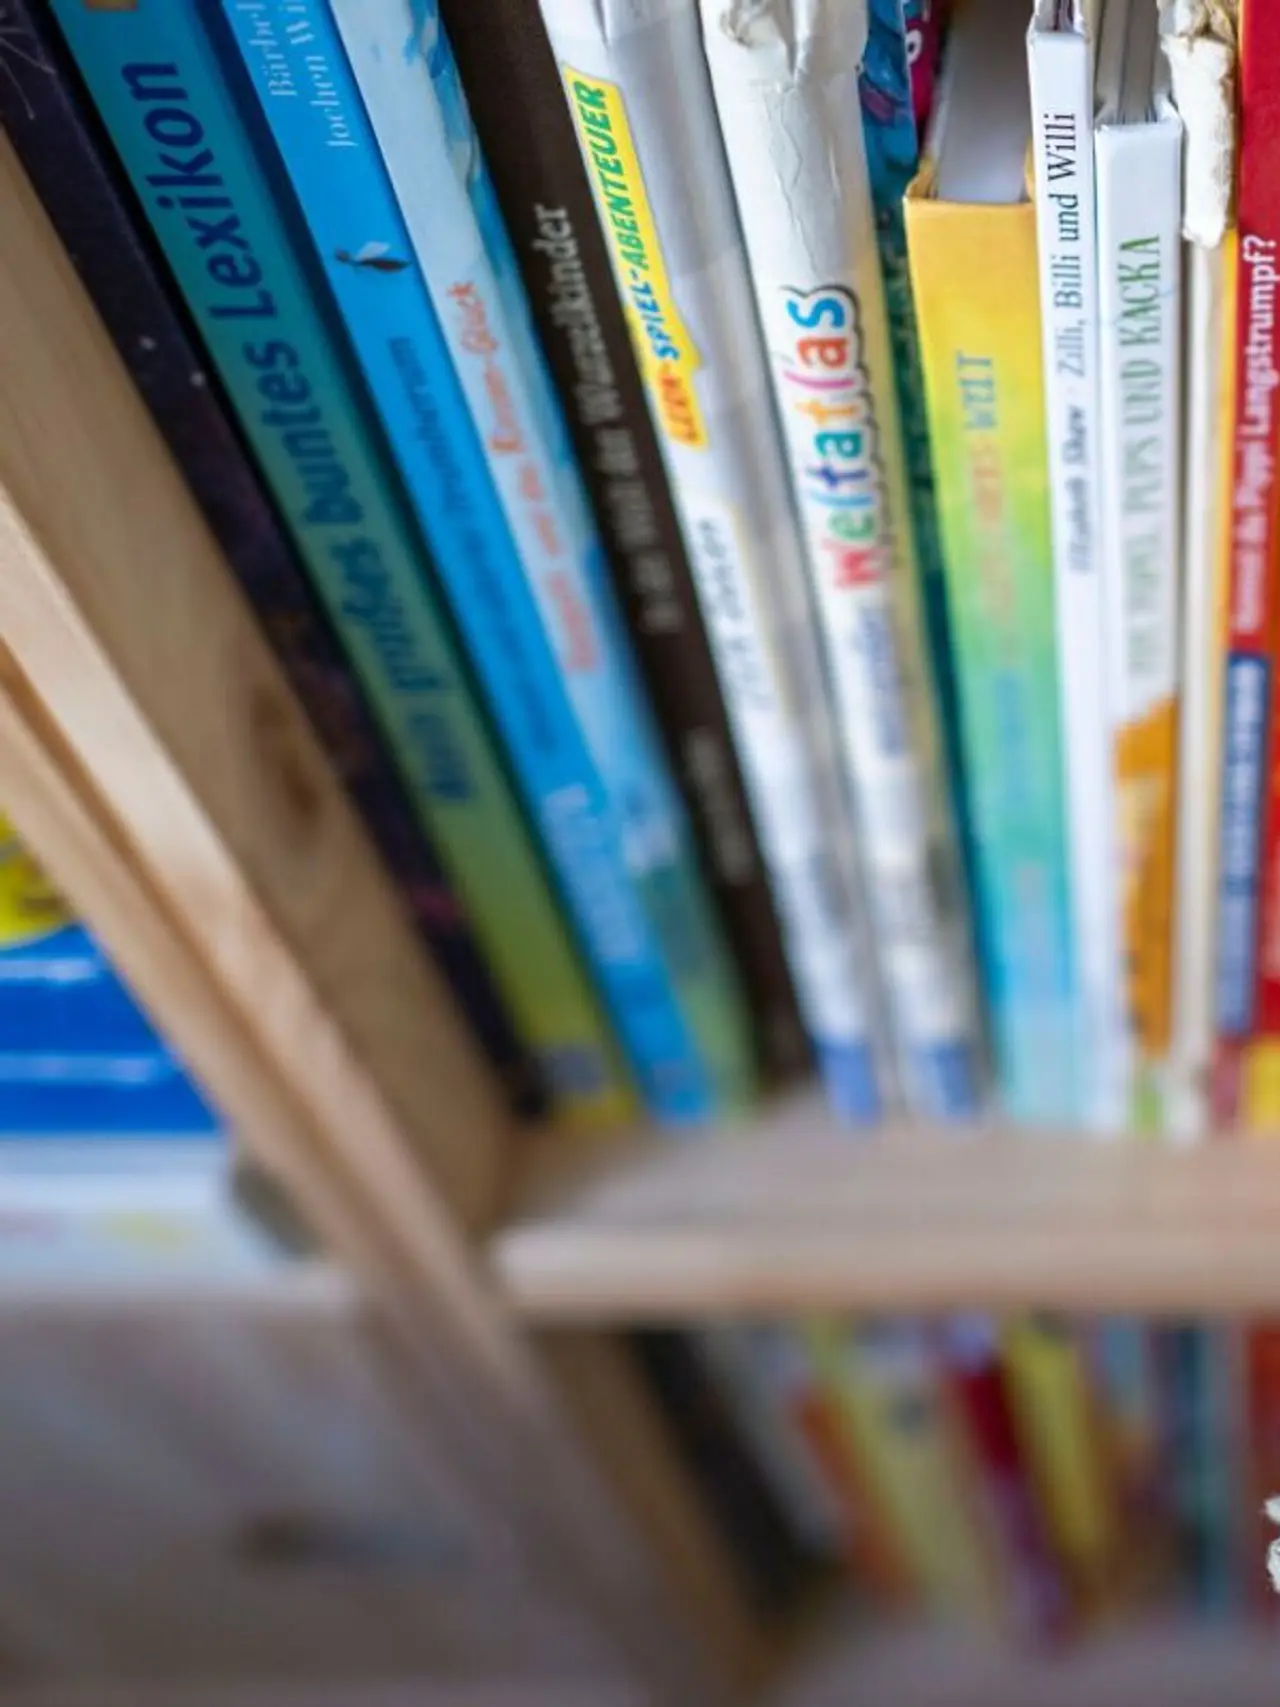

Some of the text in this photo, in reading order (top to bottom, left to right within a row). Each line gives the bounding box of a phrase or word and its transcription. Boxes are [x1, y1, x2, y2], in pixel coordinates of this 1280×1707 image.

[306, 55, 358, 147] Jochen
[121, 62, 278, 320] Lexikon
[1044, 113, 1077, 182] Willi
[1048, 193, 1080, 242] und
[1051, 254, 1084, 310] Billi
[1116, 234, 1162, 347] KACKA
[243, 338, 364, 525] buntes
